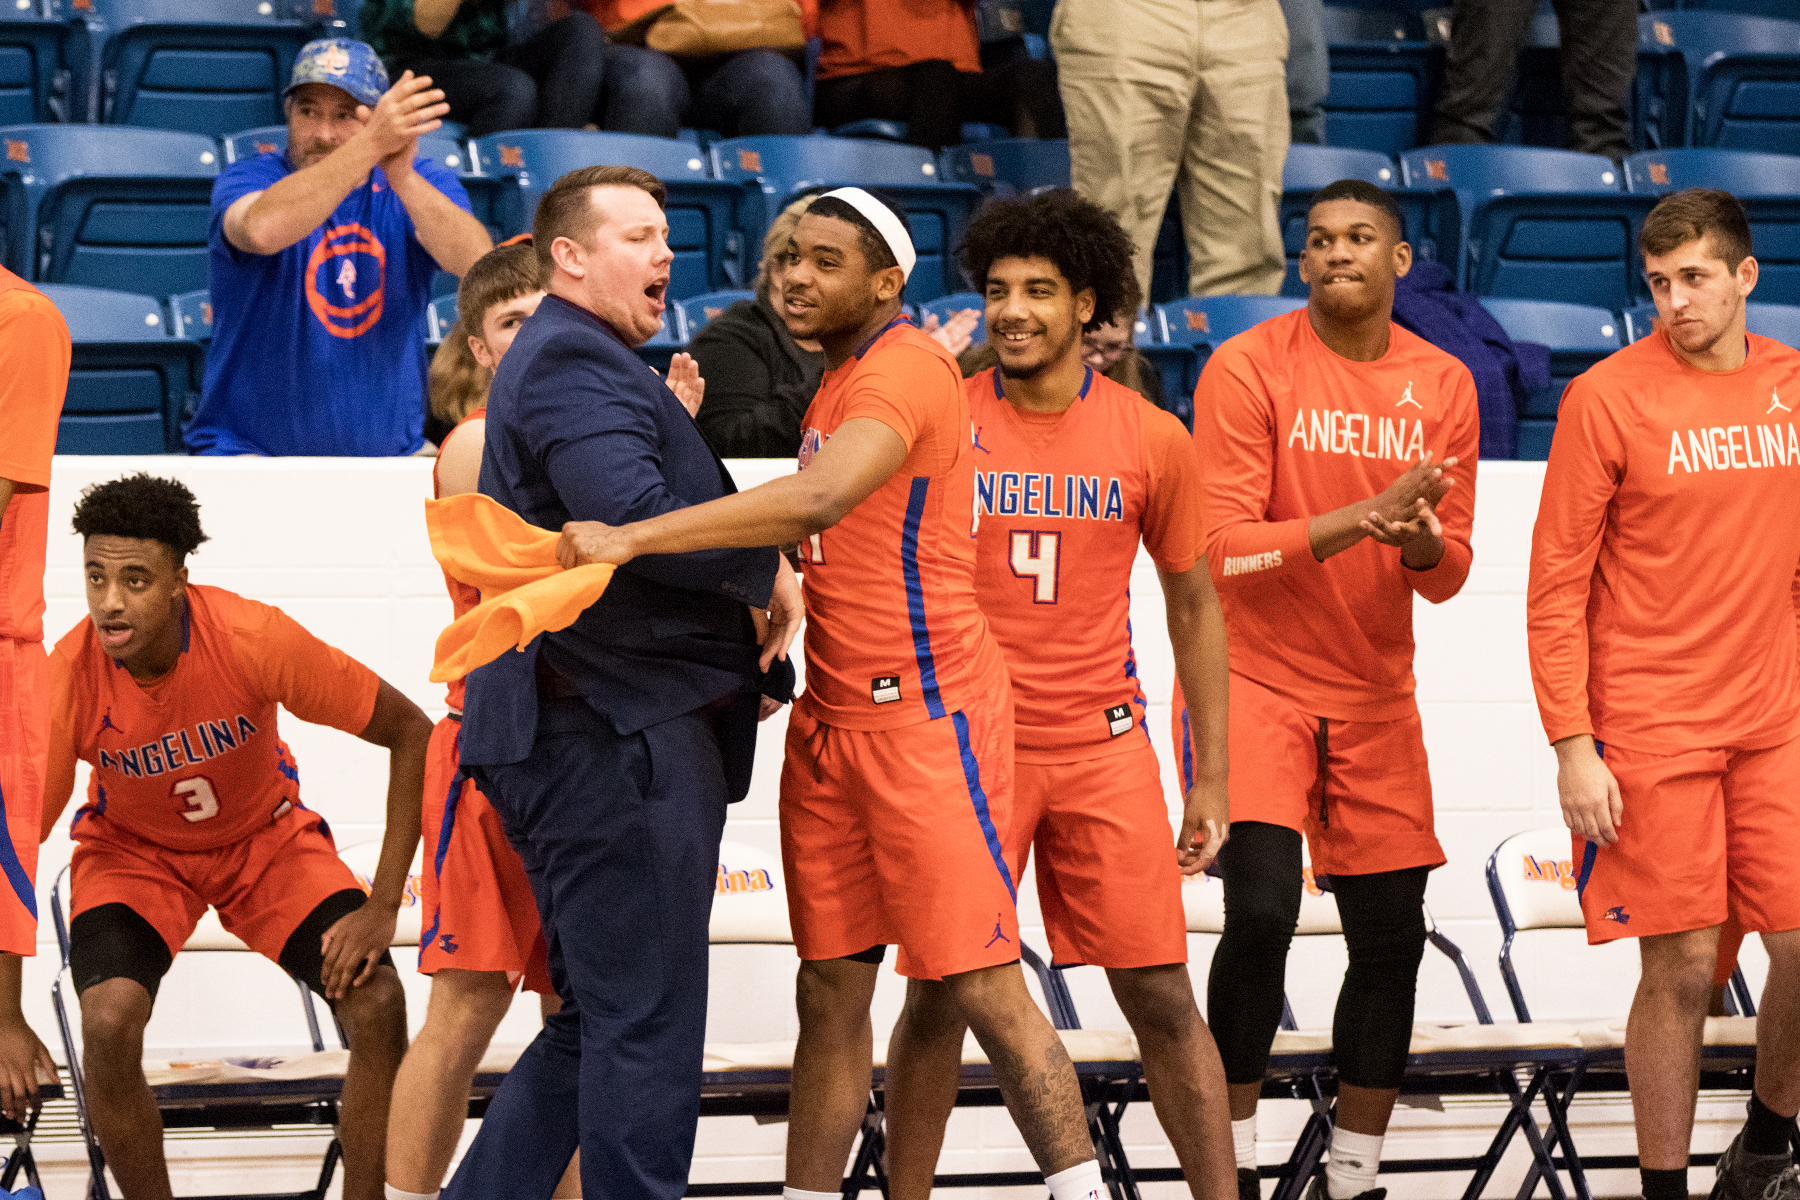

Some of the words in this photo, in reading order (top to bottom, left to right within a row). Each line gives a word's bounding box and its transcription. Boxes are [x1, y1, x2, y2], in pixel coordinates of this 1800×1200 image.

[1288, 407, 1425, 461] ANGELINA
[1667, 421, 1800, 475] ANGELINA
[976, 471, 1124, 522] NGELINA
[1009, 529, 1061, 605] 4
[1223, 549, 1283, 577] RUNNERS
[879, 678, 891, 688] M
[1112, 707, 1125, 719] M
[99, 714, 260, 779] ANGELINA
[169, 774, 222, 824] 3
